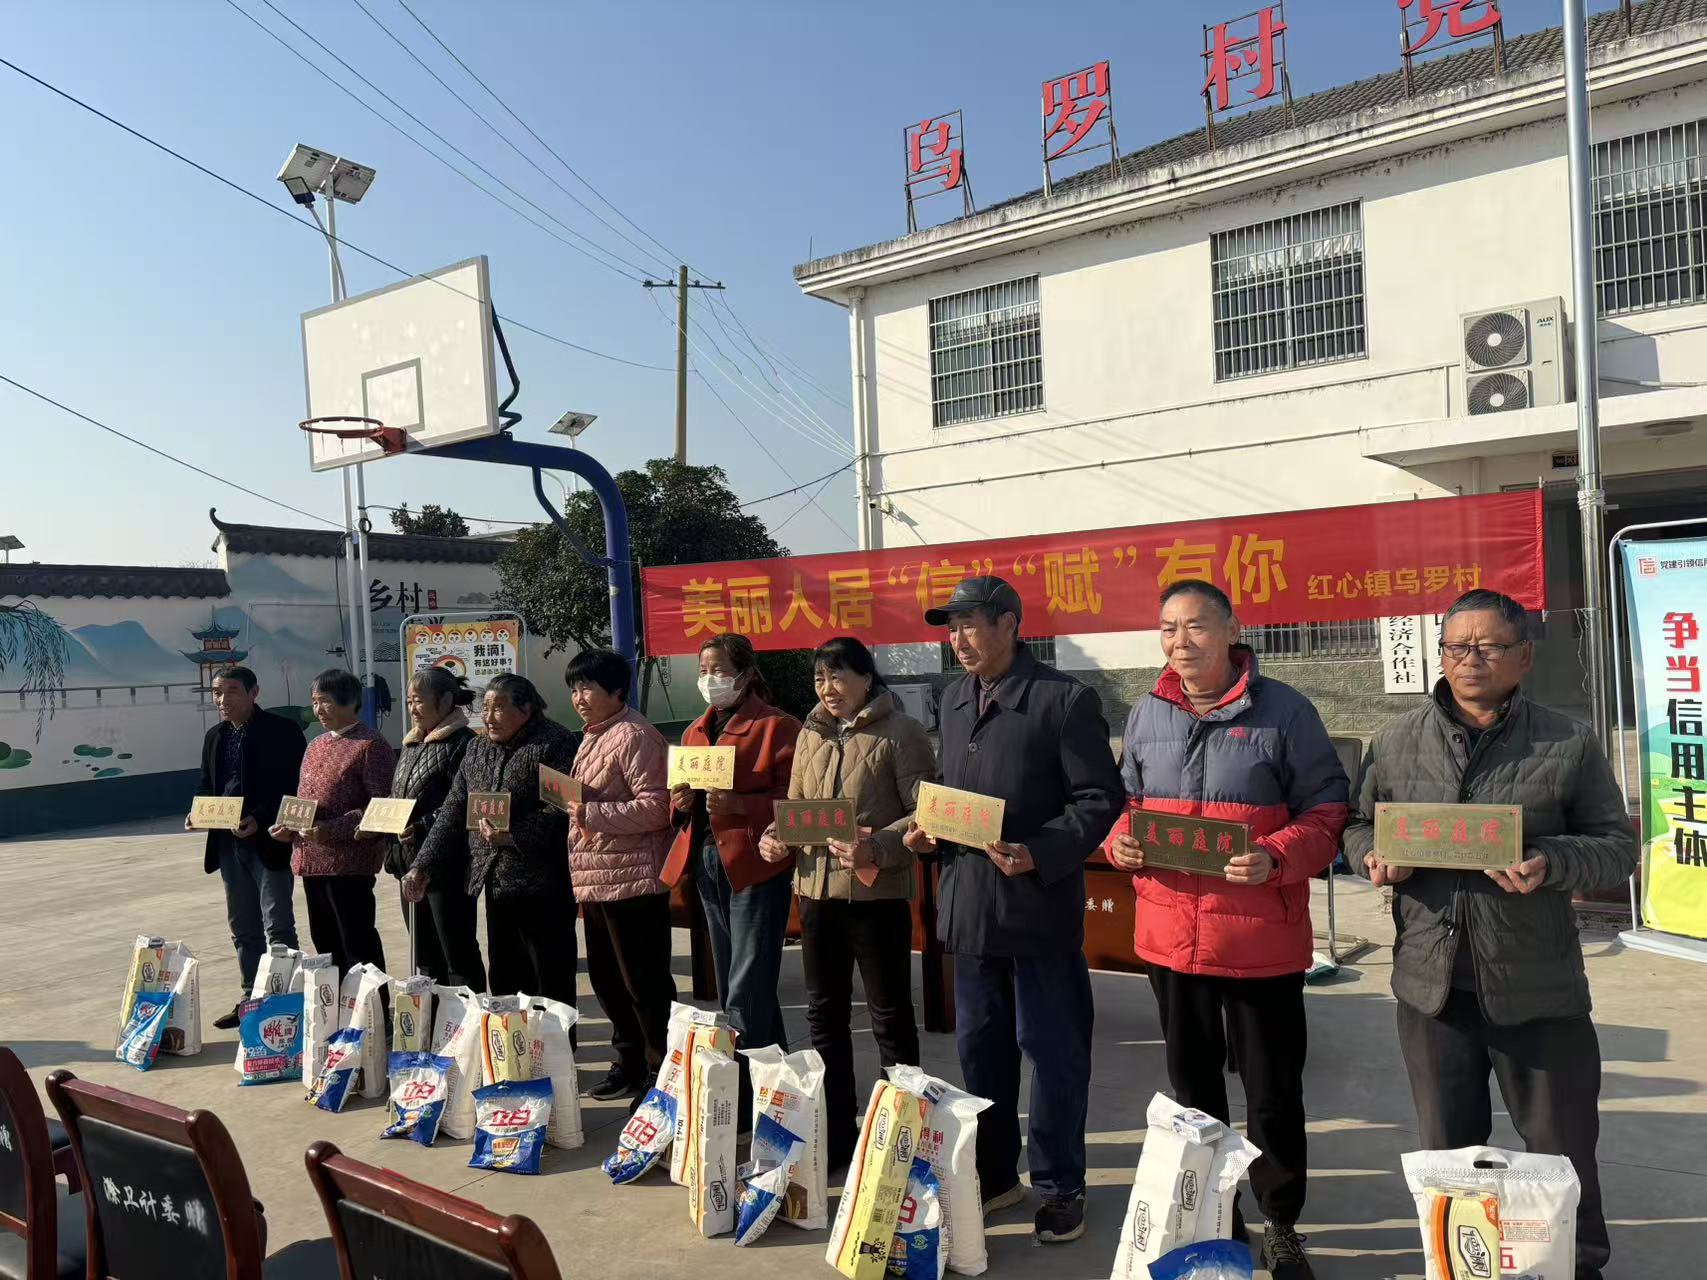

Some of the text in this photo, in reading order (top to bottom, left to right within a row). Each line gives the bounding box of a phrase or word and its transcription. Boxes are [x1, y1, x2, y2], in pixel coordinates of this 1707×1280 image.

[370, 578, 423, 613] 乡村
[1307, 562, 1482, 600] 红心镇乌罗村
[1662, 612, 1707, 867] 争当信用主体
[1144, 820, 1234, 854] 美丽庭院
[1393, 815, 1502, 846] 美丽庭院
